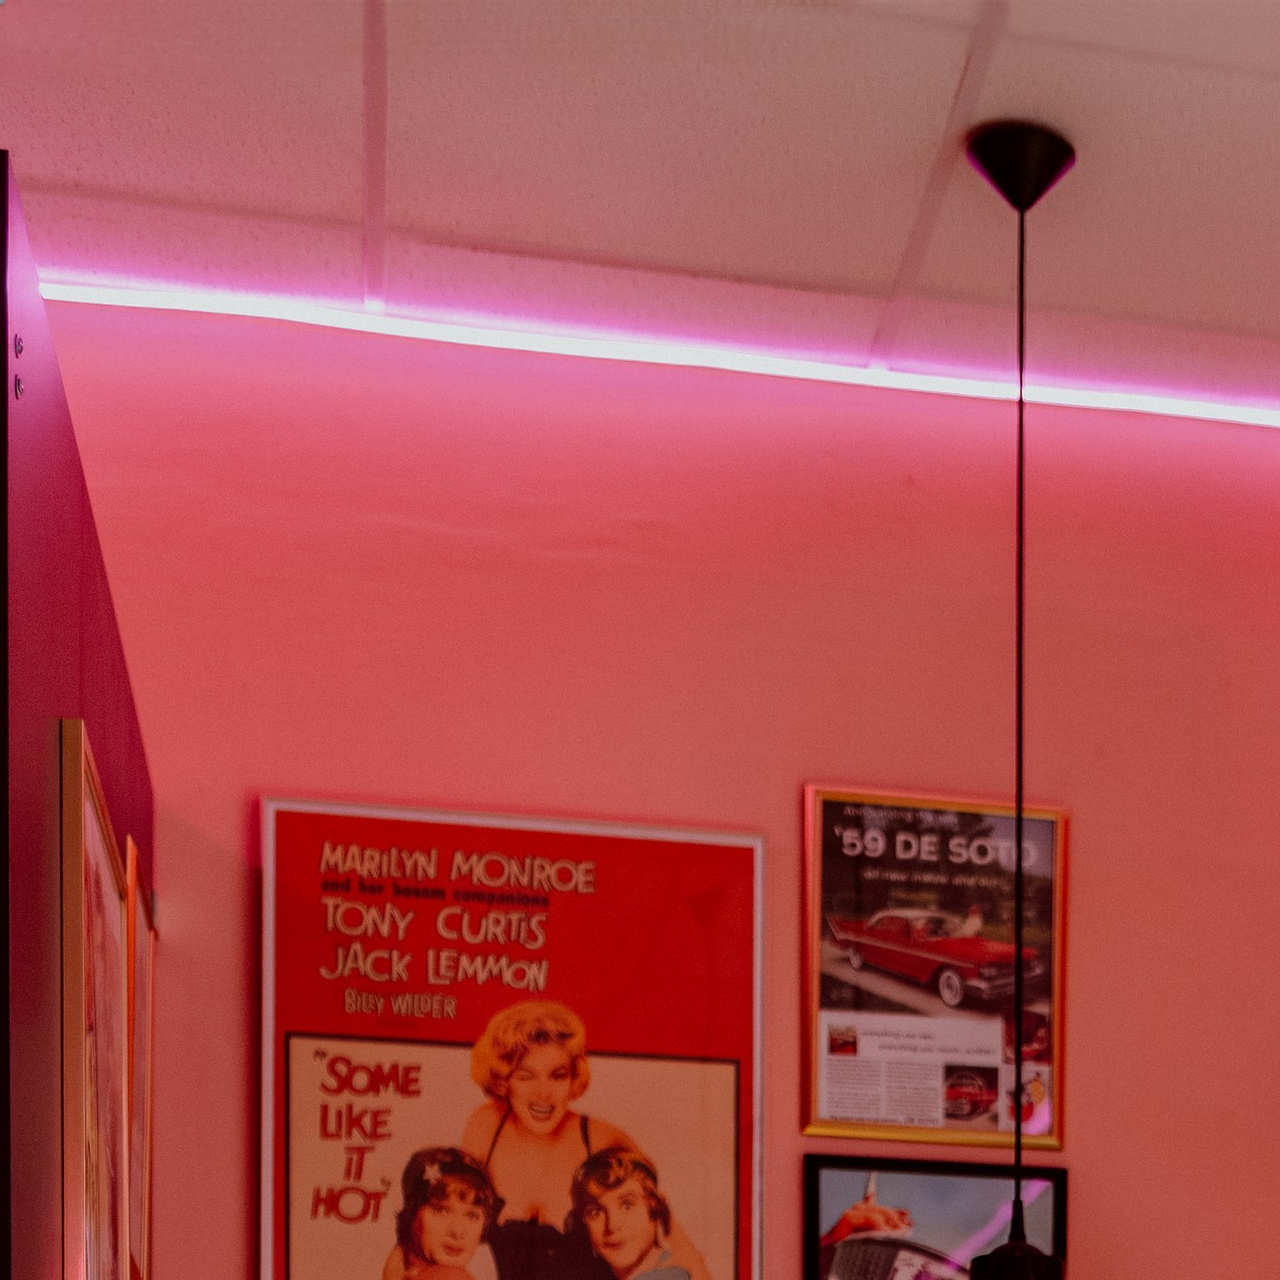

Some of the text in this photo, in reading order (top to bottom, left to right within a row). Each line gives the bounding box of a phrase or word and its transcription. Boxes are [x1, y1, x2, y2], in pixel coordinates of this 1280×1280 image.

[895, 831, 940, 862] DE
[319, 839, 597, 894] MARILYN MONROE
[392, 883, 445, 900] bosom
[320, 896, 547, 950] TONY CURTIS
[319, 940, 549, 992] JACK LEMMON
[344, 988, 457, 1020] BILLY WILDER
[320, 1103, 392, 1140] LIKE
[344, 1146, 375, 1181] IT
